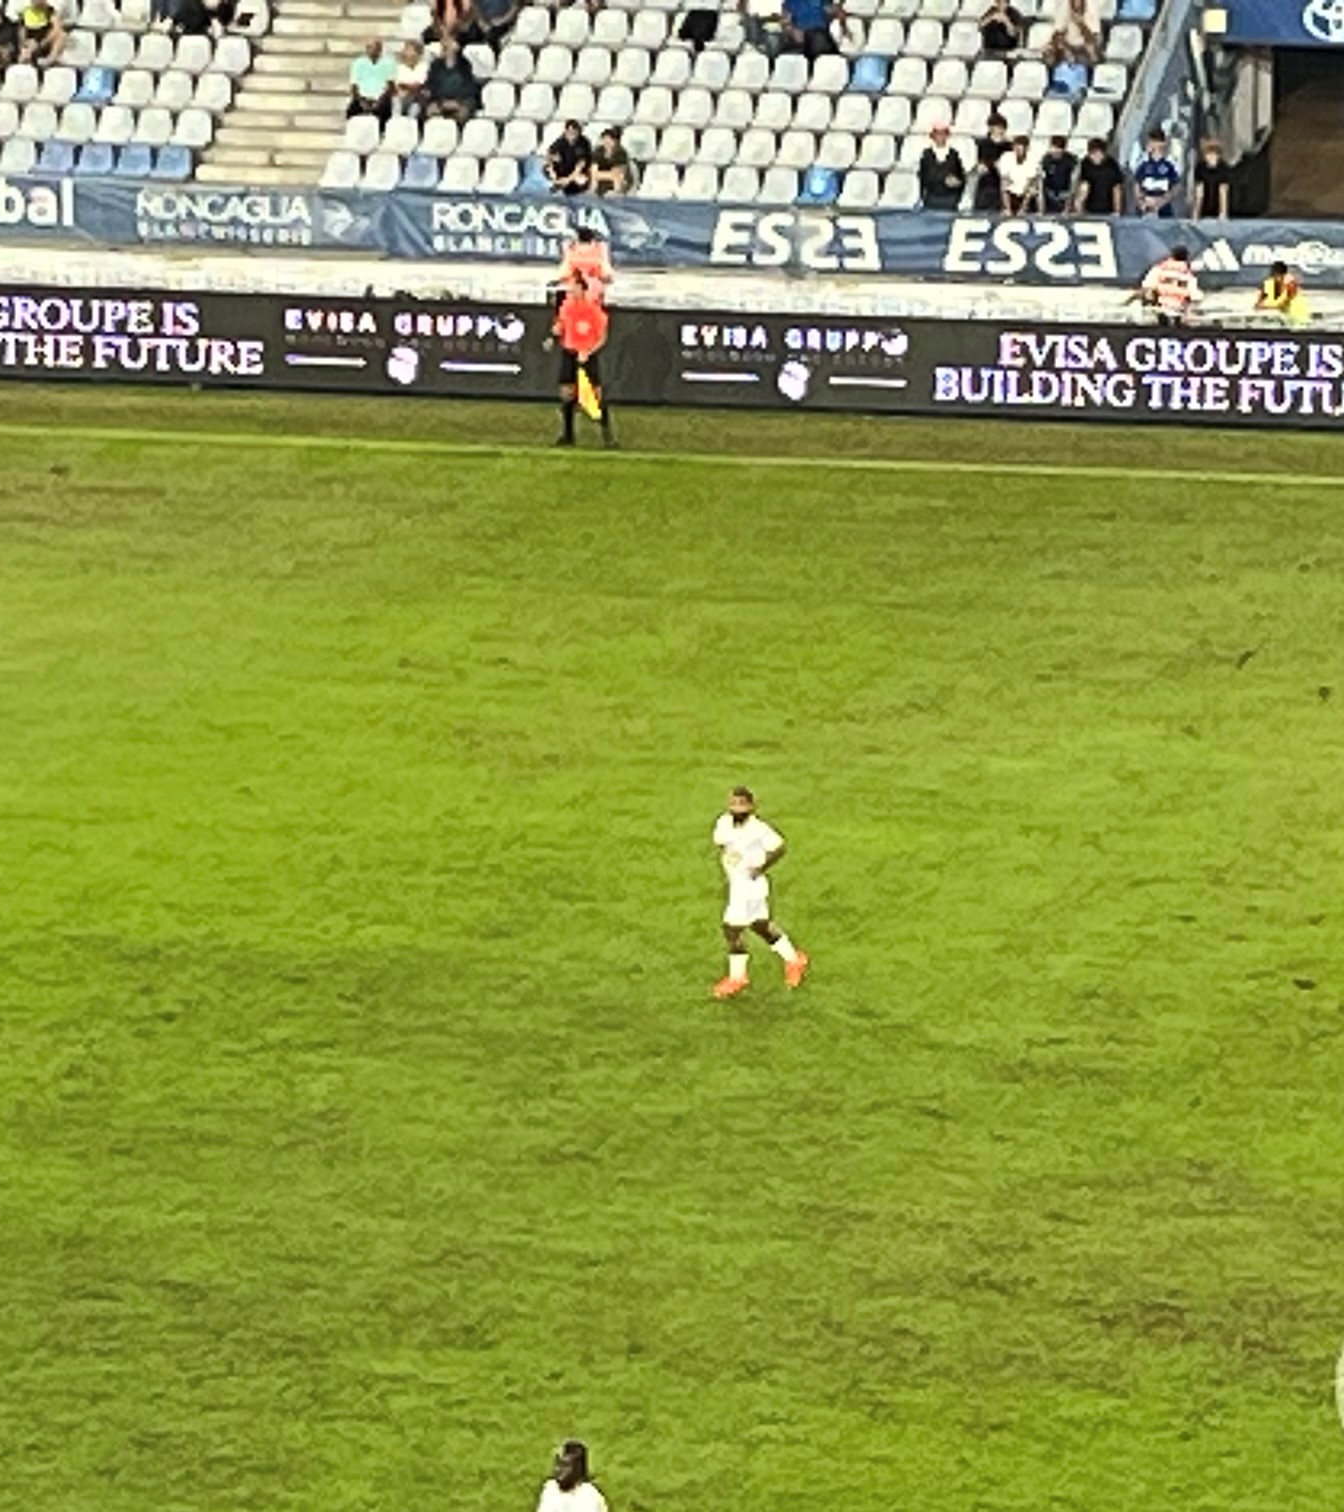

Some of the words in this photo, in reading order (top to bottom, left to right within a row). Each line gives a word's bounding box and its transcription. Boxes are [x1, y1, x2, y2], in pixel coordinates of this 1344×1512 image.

[135, 190, 312, 225] RONCAGLIA
[161, 301, 200, 336] IS
[284, 308, 377, 334] EVISA
[680, 324, 768, 349] EVISA
[92, 334, 265, 375] FUTURE
[997, 332, 1118, 371] EVISA
[1125, 337, 1301, 376] GROUPE
[1306, 343, 1344, 378] IS
[934, 366, 1137, 408] BUILDING
[1141, 373, 1230, 412] THE
